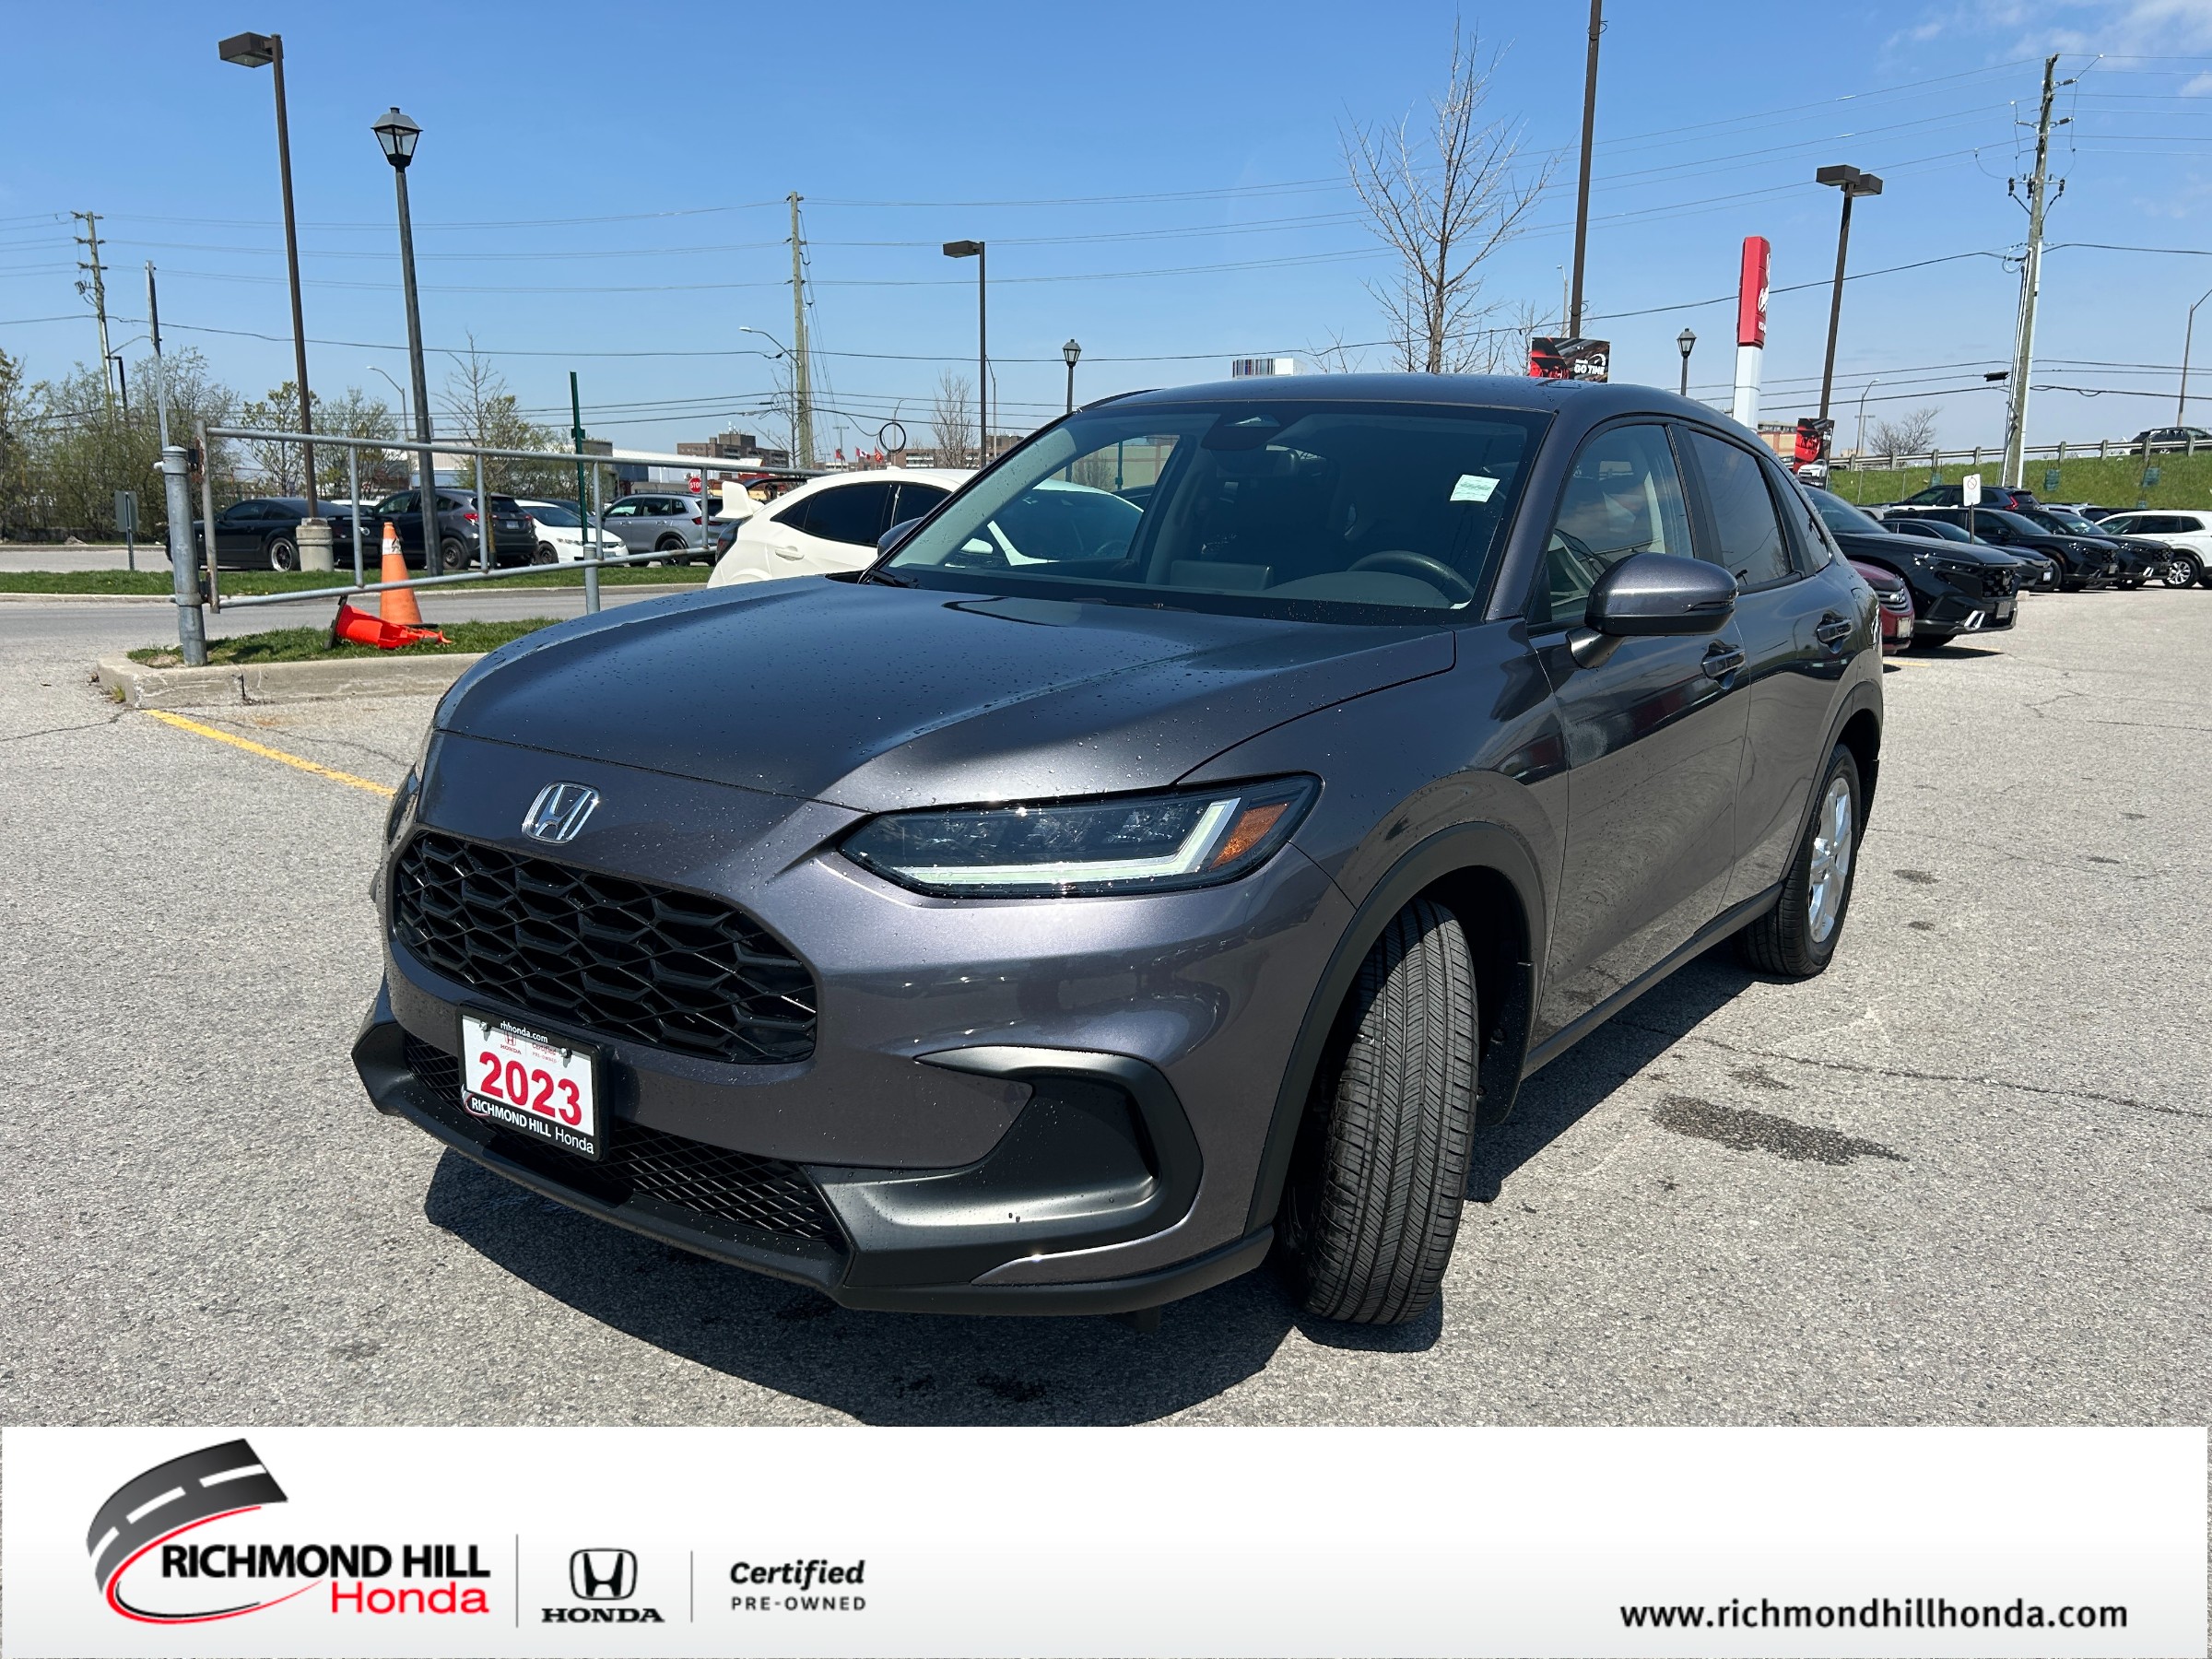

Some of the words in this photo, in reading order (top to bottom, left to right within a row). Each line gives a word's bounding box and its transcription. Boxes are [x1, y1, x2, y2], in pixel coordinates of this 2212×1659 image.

[1574, 364, 1587, 373] GO
[1588, 365, 1605, 374] TIME
[500, 1020, 548, 1043] rhhonda.com
[479, 1051, 582, 1126] 2023
[471, 1097, 527, 1128] RICHMOND
[528, 1117, 552, 1137] HILL
[555, 1126, 594, 1154] Honda
